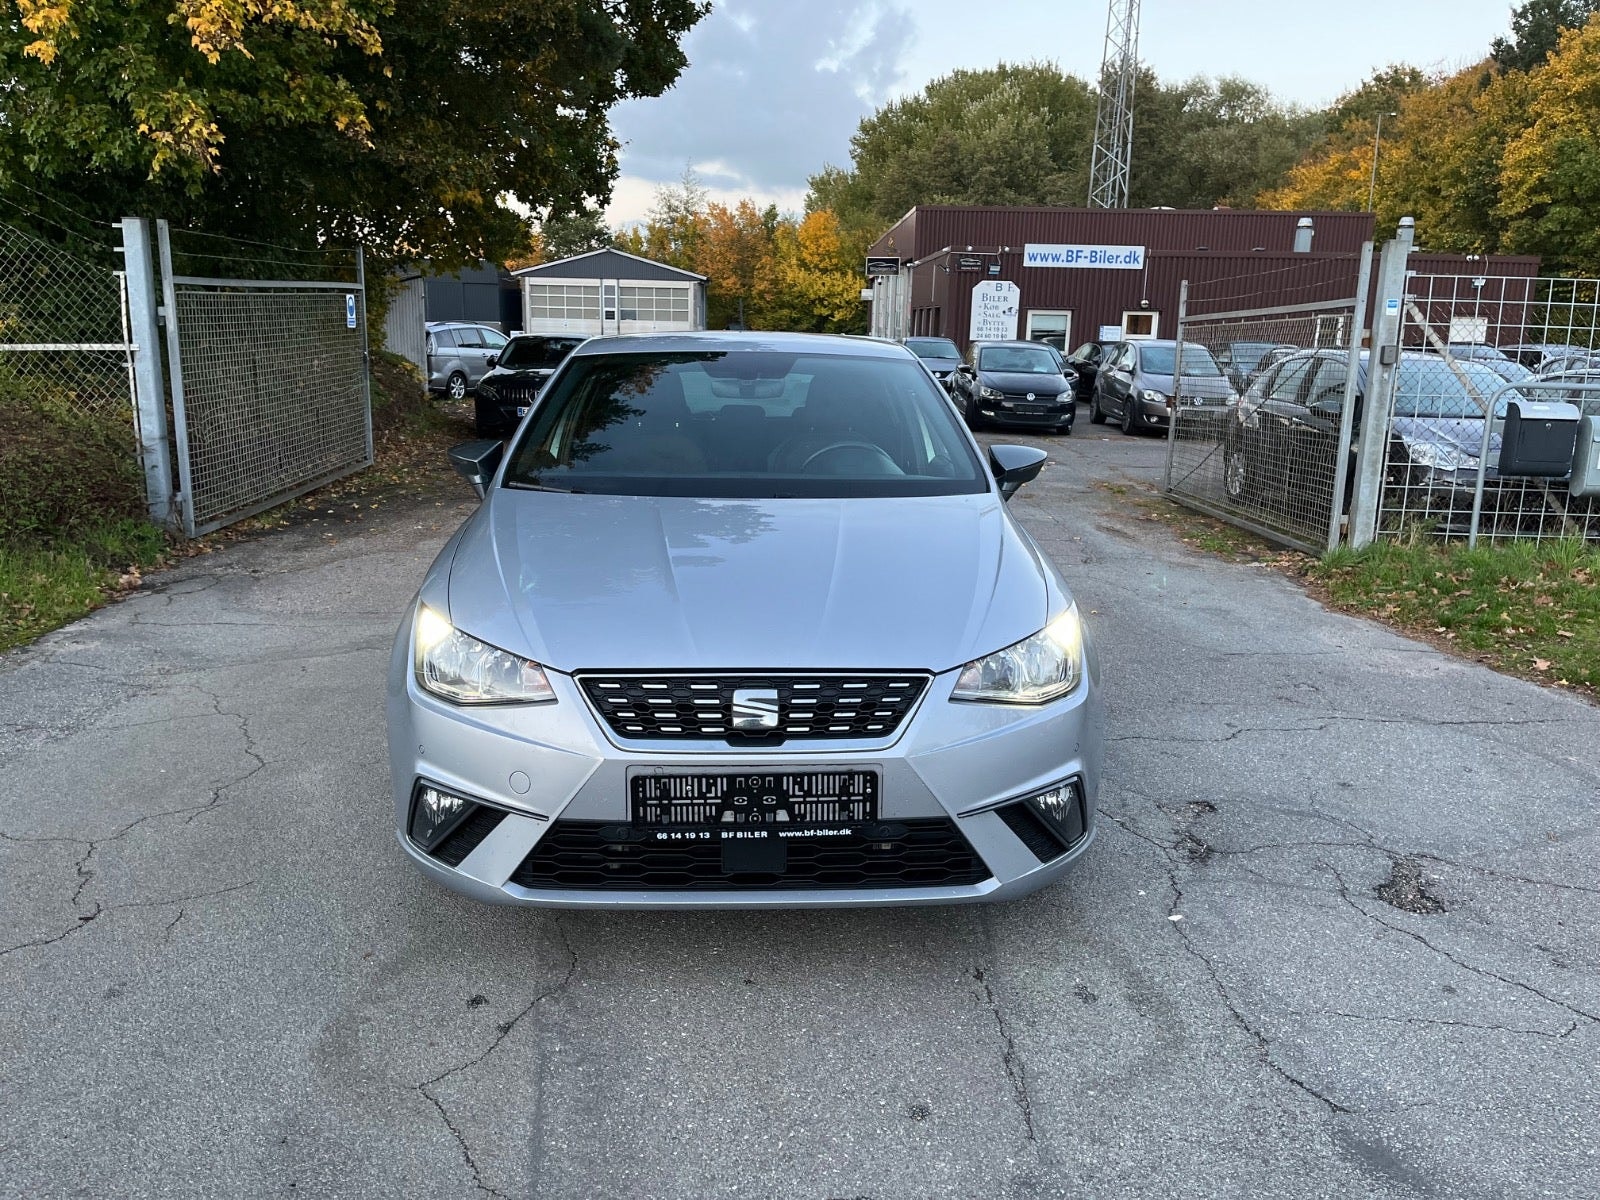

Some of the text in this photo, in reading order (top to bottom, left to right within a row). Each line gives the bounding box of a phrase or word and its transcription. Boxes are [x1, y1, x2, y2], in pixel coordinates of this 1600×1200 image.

[1028, 249, 1140, 265] www.BF-Biler.dk
[656, 832, 668, 840] 66
[670, 832, 682, 840] 14
[778, 828, 852, 837] www.bf-biler.dk
